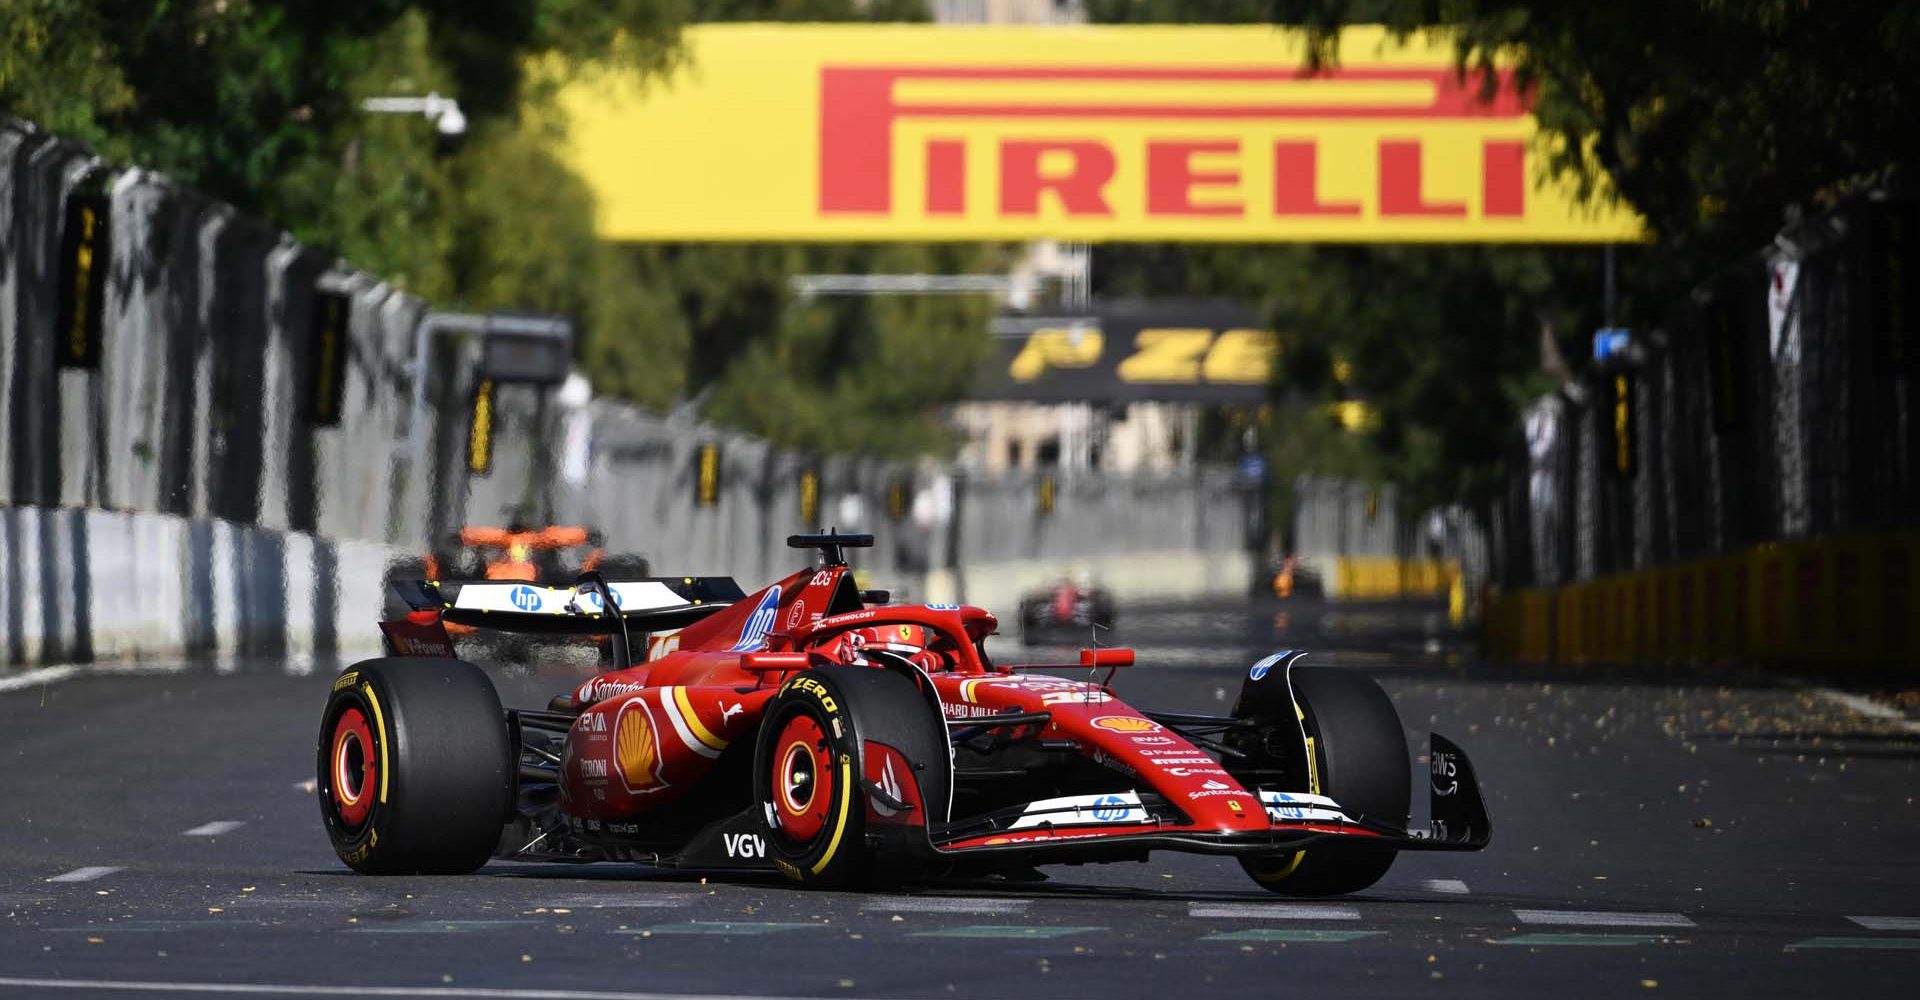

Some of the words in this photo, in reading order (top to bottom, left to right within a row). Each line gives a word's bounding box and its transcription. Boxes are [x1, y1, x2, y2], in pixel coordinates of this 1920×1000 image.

[818, 66, 1538, 218] PIRELLI
[515, 586, 538, 611] hp
[828, 611, 876, 624] TECHNOLOGY
[791, 677, 838, 713] ZERO
[1098, 796, 1125, 820] hp
